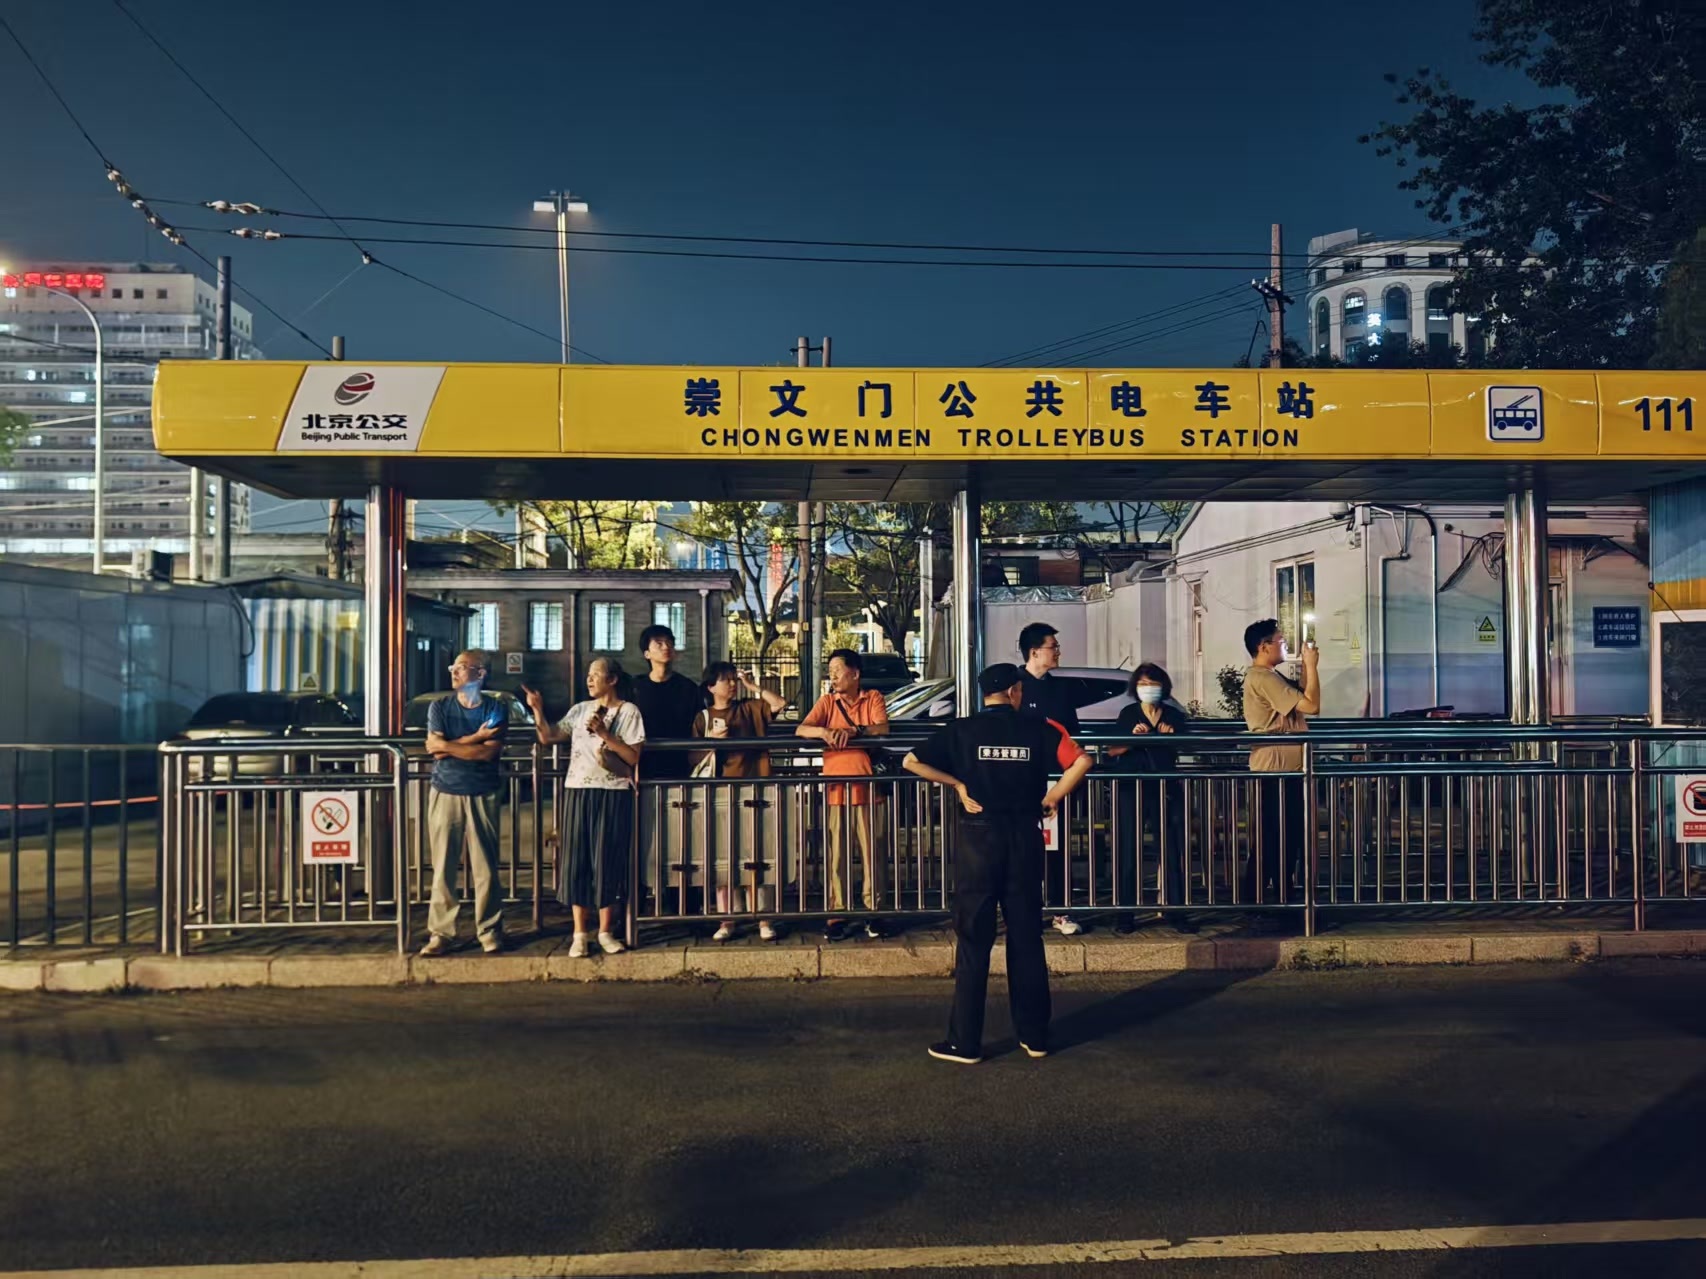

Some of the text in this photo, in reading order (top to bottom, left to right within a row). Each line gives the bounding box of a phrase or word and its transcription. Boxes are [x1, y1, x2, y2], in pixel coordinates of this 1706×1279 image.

[684, 378, 1316, 420] 崇文门公共电车站
[301, 413, 408, 430] 北京公交
[1634, 397, 1693, 432] 111
[301, 431, 408, 443] Beijing Public Transport
[701, 428, 1298, 447] CHONGWENMEN TROLLEYBUS STATION
